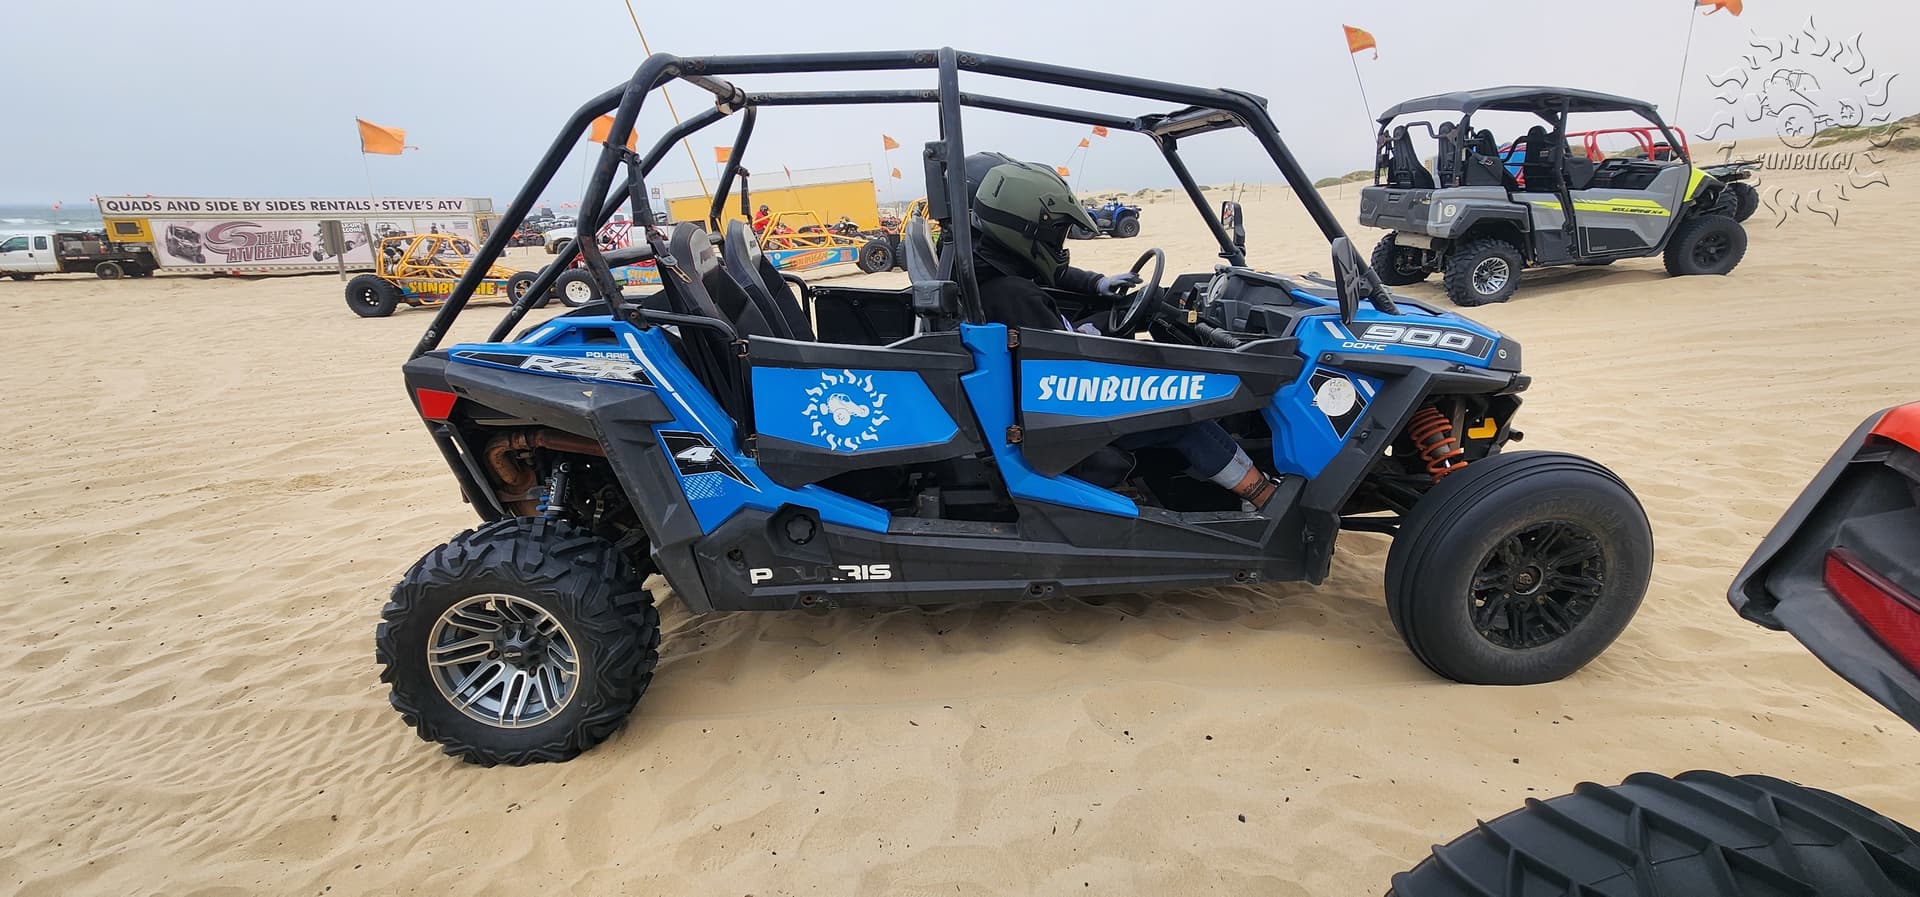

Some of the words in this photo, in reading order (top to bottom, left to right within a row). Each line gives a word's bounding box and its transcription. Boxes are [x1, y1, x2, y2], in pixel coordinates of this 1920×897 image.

[106, 200, 162, 212] QUADS
[166, 200, 201, 211] AND
[205, 200, 240, 211] SIDE
[242, 200, 261, 211] BY
[265, 200, 306, 211] SIDES
[310, 200, 371, 211] RENTALS
[381, 200, 434, 210] STEVE'S
[437, 200, 463, 210] ATV
[227, 246, 255, 263] ATV
[255, 241, 312, 261] RENTALS
[1360, 323, 1474, 350] 900
[1341, 341, 1388, 351] DOHC
[585, 351, 630, 360] POLARIS
[1038, 375, 1206, 402] SUNBUGGIE
[676, 445, 716, 463] 4
